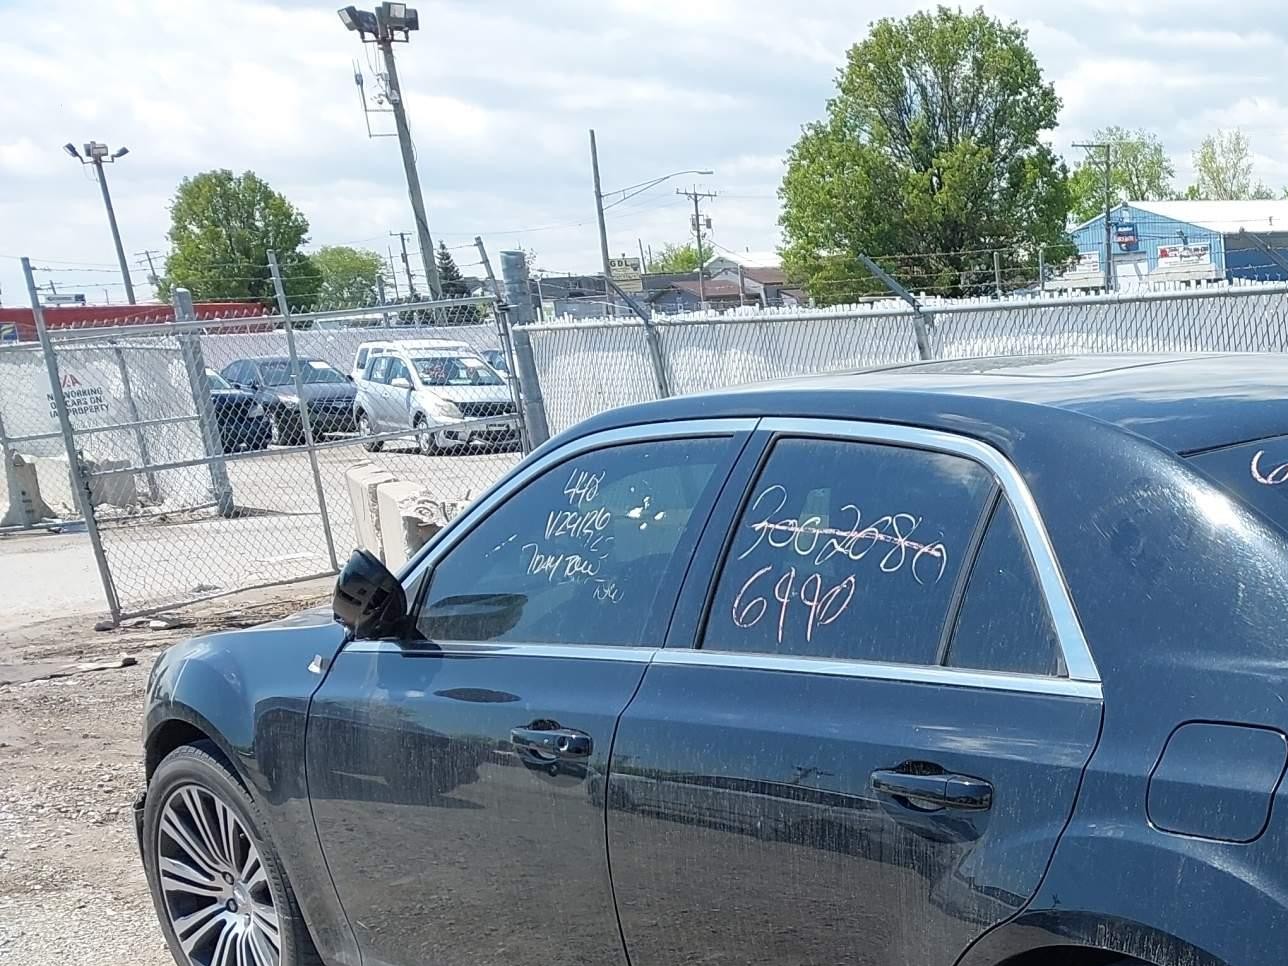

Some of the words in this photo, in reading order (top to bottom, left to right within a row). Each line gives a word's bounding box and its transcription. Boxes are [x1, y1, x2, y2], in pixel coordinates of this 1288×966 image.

[65, 397, 88, 408] CARS
[89, 395, 102, 405] ON
[67, 403, 110, 416] PROPERTY
